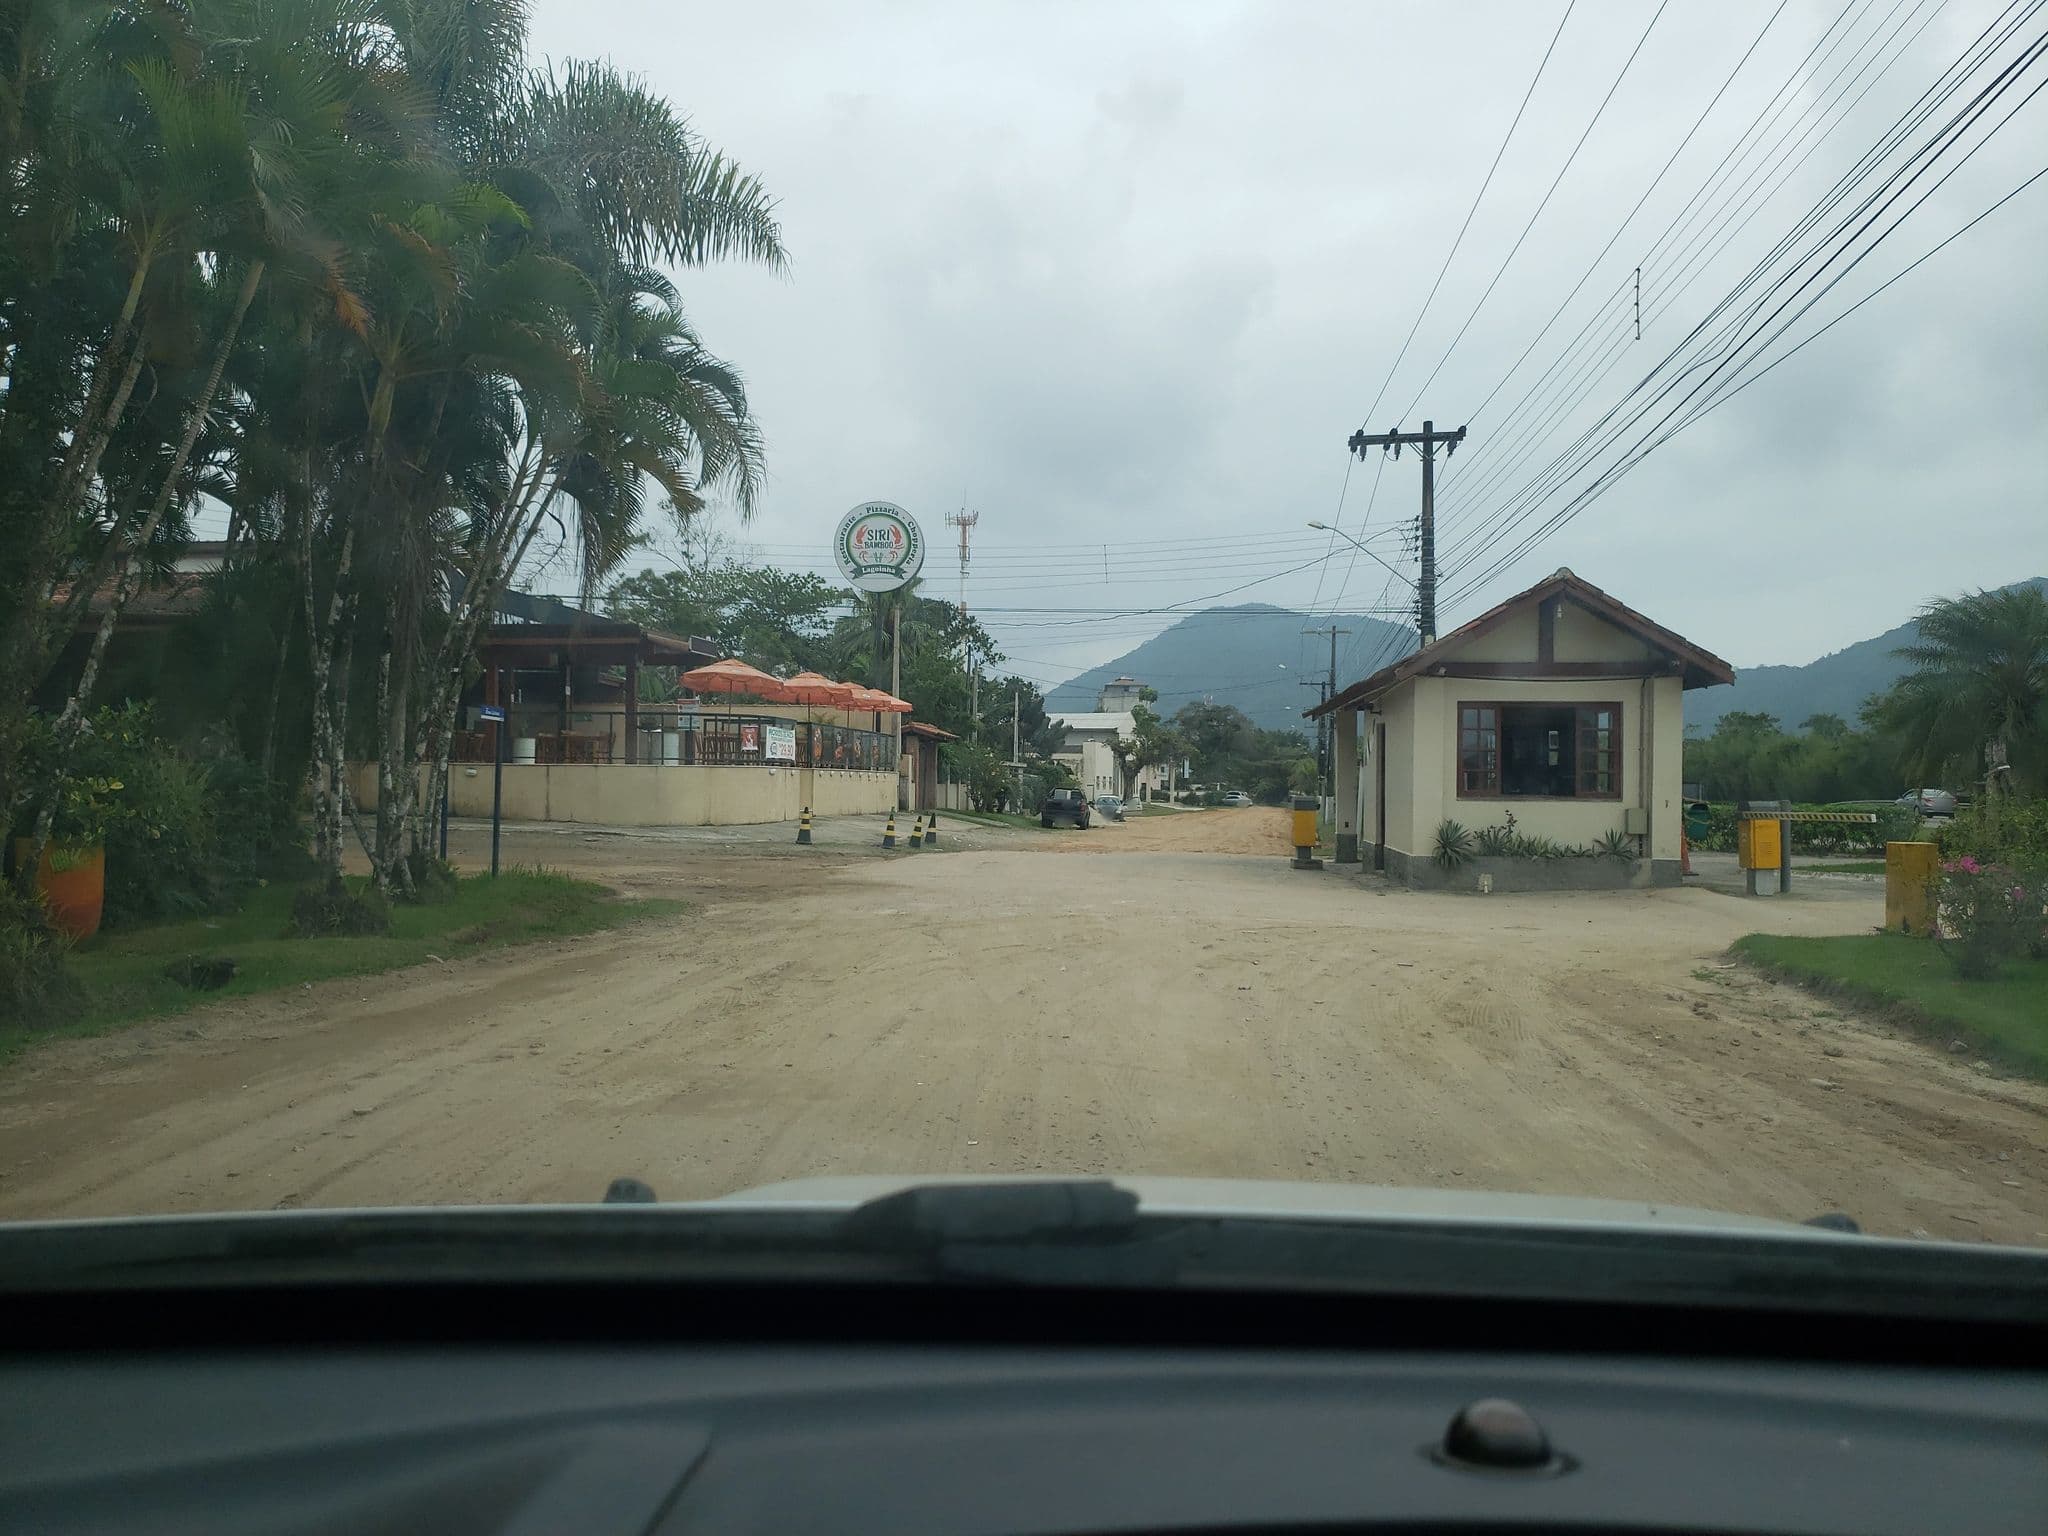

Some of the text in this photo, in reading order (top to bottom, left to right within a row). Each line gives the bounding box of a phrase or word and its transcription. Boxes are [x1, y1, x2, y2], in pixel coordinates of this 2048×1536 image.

[839, 516, 857, 566] Restaurante
[865, 506, 899, 516] Pizzaria
[867, 528, 890, 541] SIRI
[864, 541, 894, 549] BAMBOO
